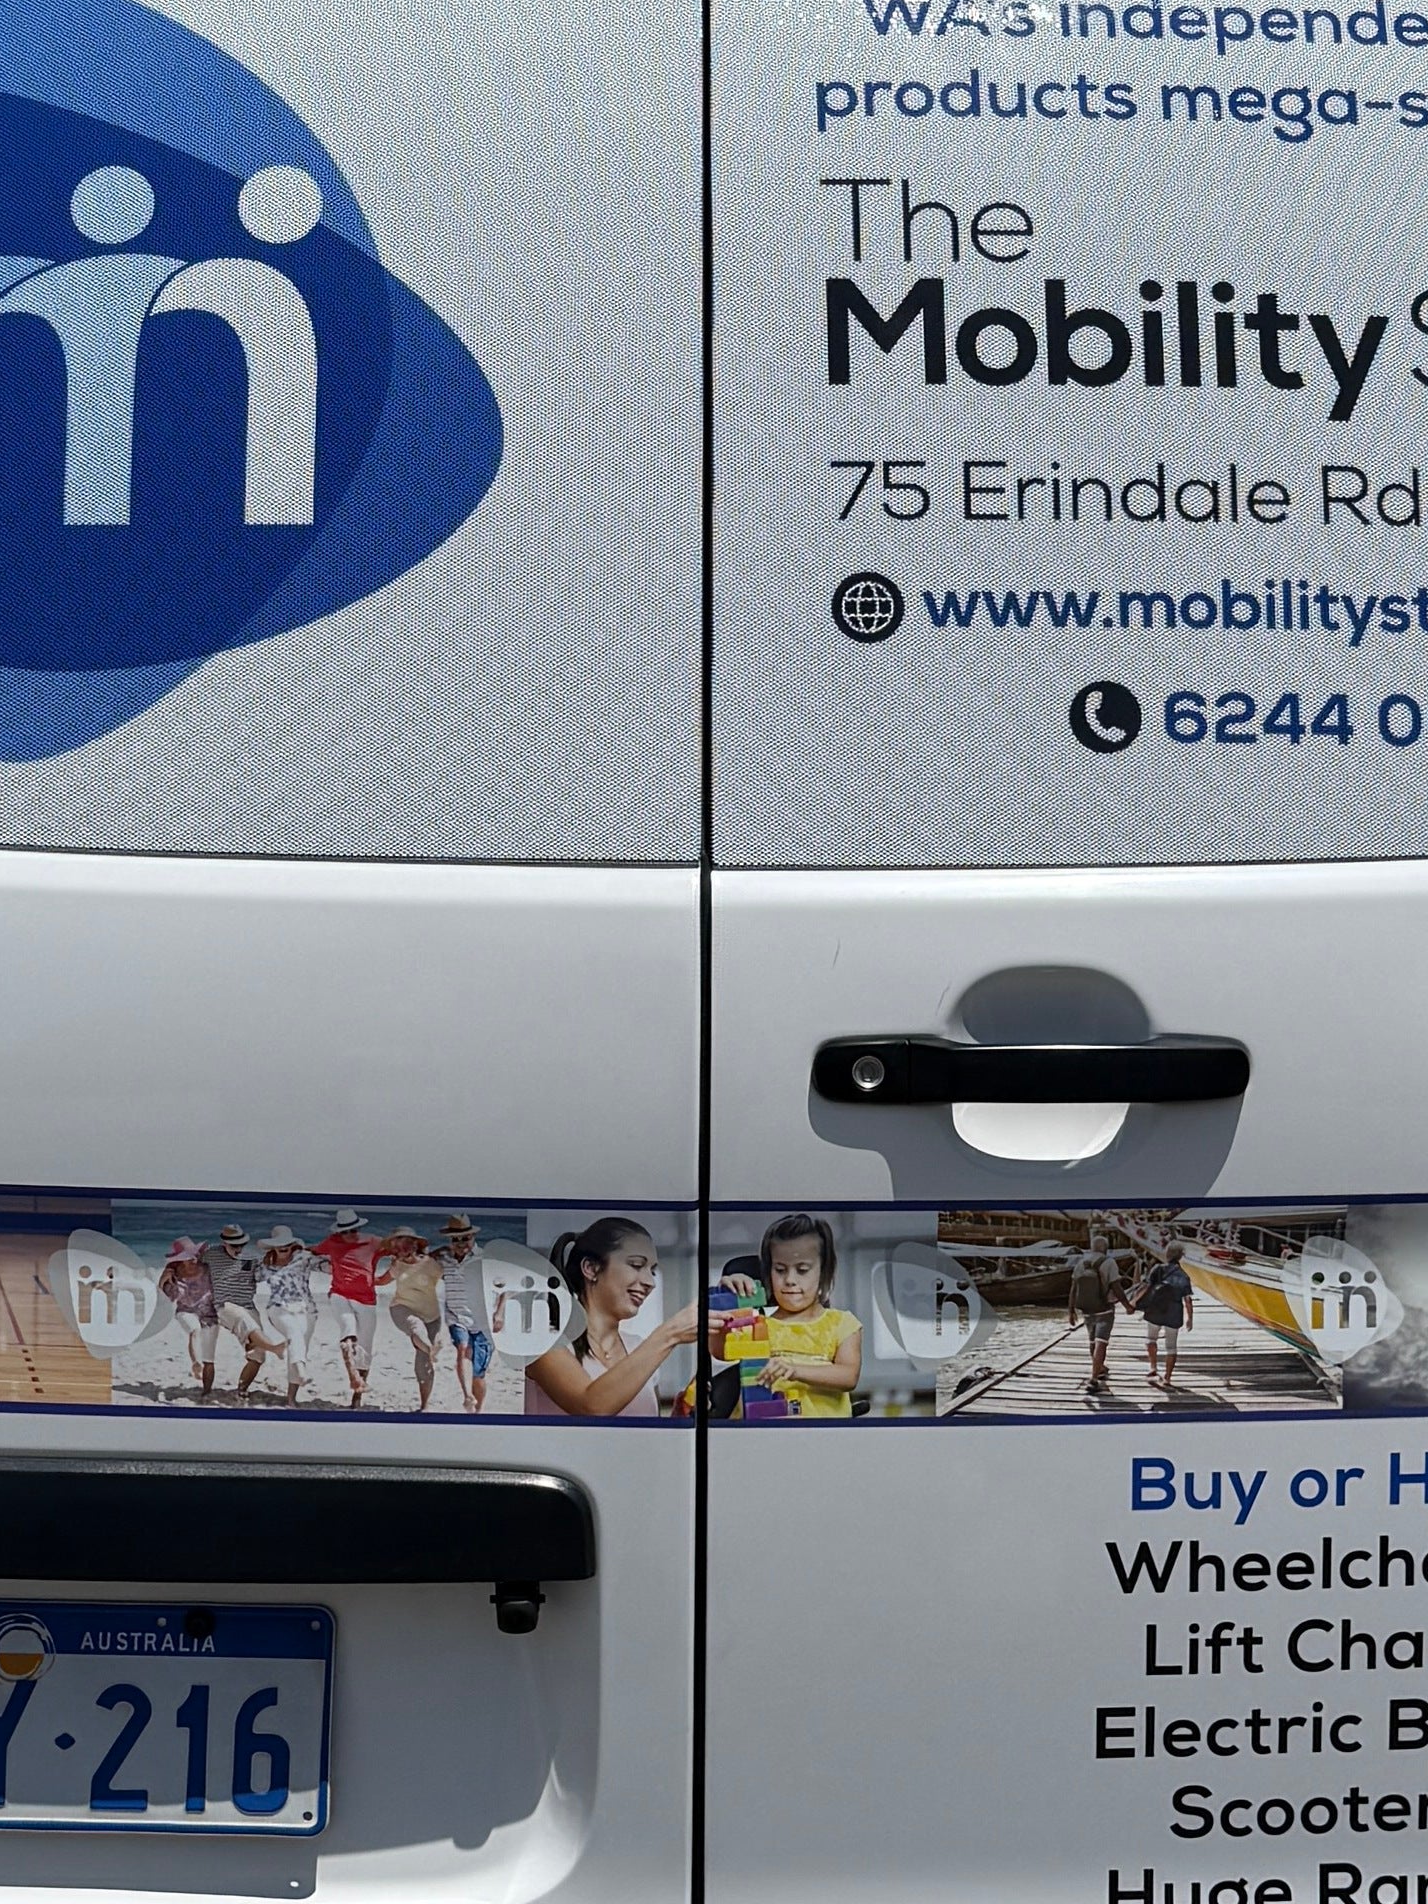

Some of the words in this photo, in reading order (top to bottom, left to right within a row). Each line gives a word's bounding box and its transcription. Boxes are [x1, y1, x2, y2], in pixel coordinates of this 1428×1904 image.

[814, 70, 1138, 132] products
[819, 177, 1035, 264] The
[828, 458, 930, 521] 75
[962, 458, 1292, 527] Erindale
[1322, 462, 1423, 529] Rd
[1162, 690, 1354, 747] 6244
[1130, 1456, 1268, 1526] Buy
[1289, 1466, 1365, 1508] or
[79, 1631, 217, 1654] AUSTRALIA
[1145, 1621, 1265, 1676] Lift
[1095, 1701, 1364, 1759] Electric
